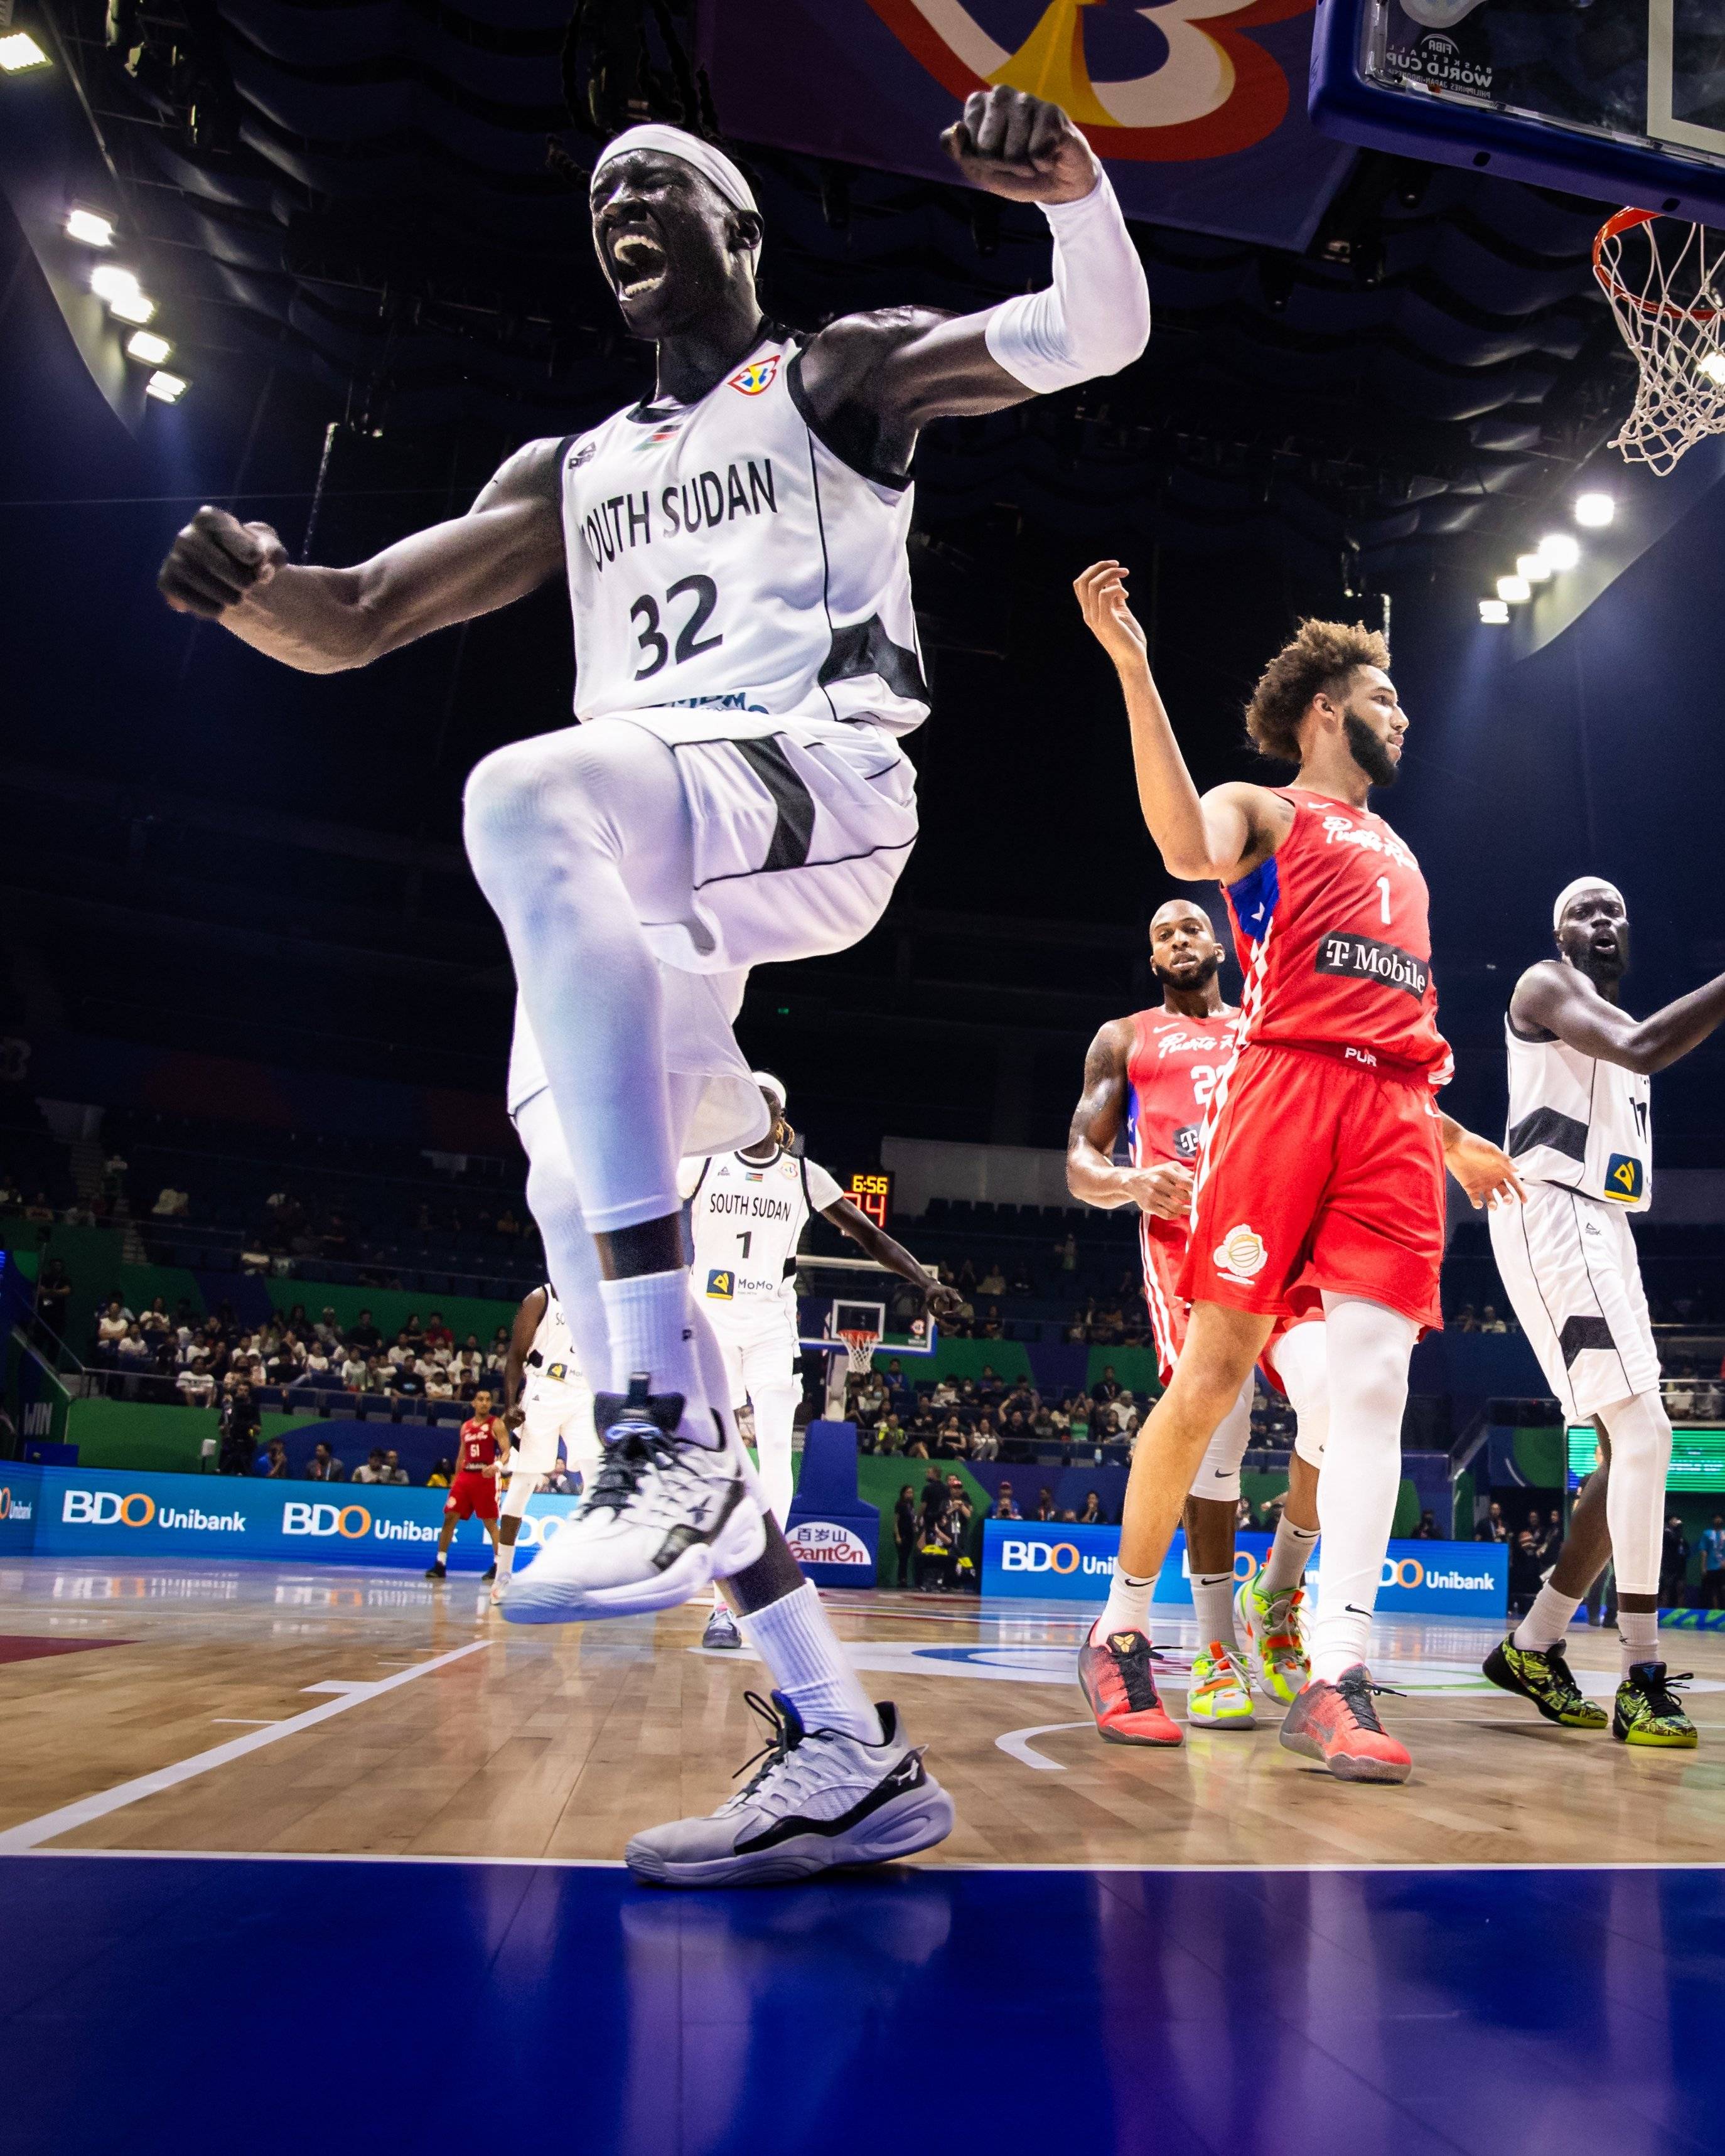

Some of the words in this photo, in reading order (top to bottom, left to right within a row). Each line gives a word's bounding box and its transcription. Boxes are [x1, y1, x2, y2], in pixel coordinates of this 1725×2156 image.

[581, 491, 651, 572] OUTH
[662, 459, 778, 538] SUDAN
[630, 574, 723, 681] 32
[1377, 876, 1391, 925] 1
[1353, 944, 1426, 993] Mobile
[1345, 1047, 1377, 1066] PUR
[853, 1175, 888, 1194] 6:56
[710, 1193, 749, 1216] SOUTH
[752, 1197, 792, 1221] SUDAN
[736, 1231, 752, 1259] 1
[738, 1279, 773, 1290] MoMo
[63, 1490, 155, 1528] BDO
[158, 1508, 247, 1531] Unibank
[282, 1502, 372, 1539] BDO
[1002, 1541, 1080, 1574] BDO
[1426, 1571, 1495, 1590] Unibank
